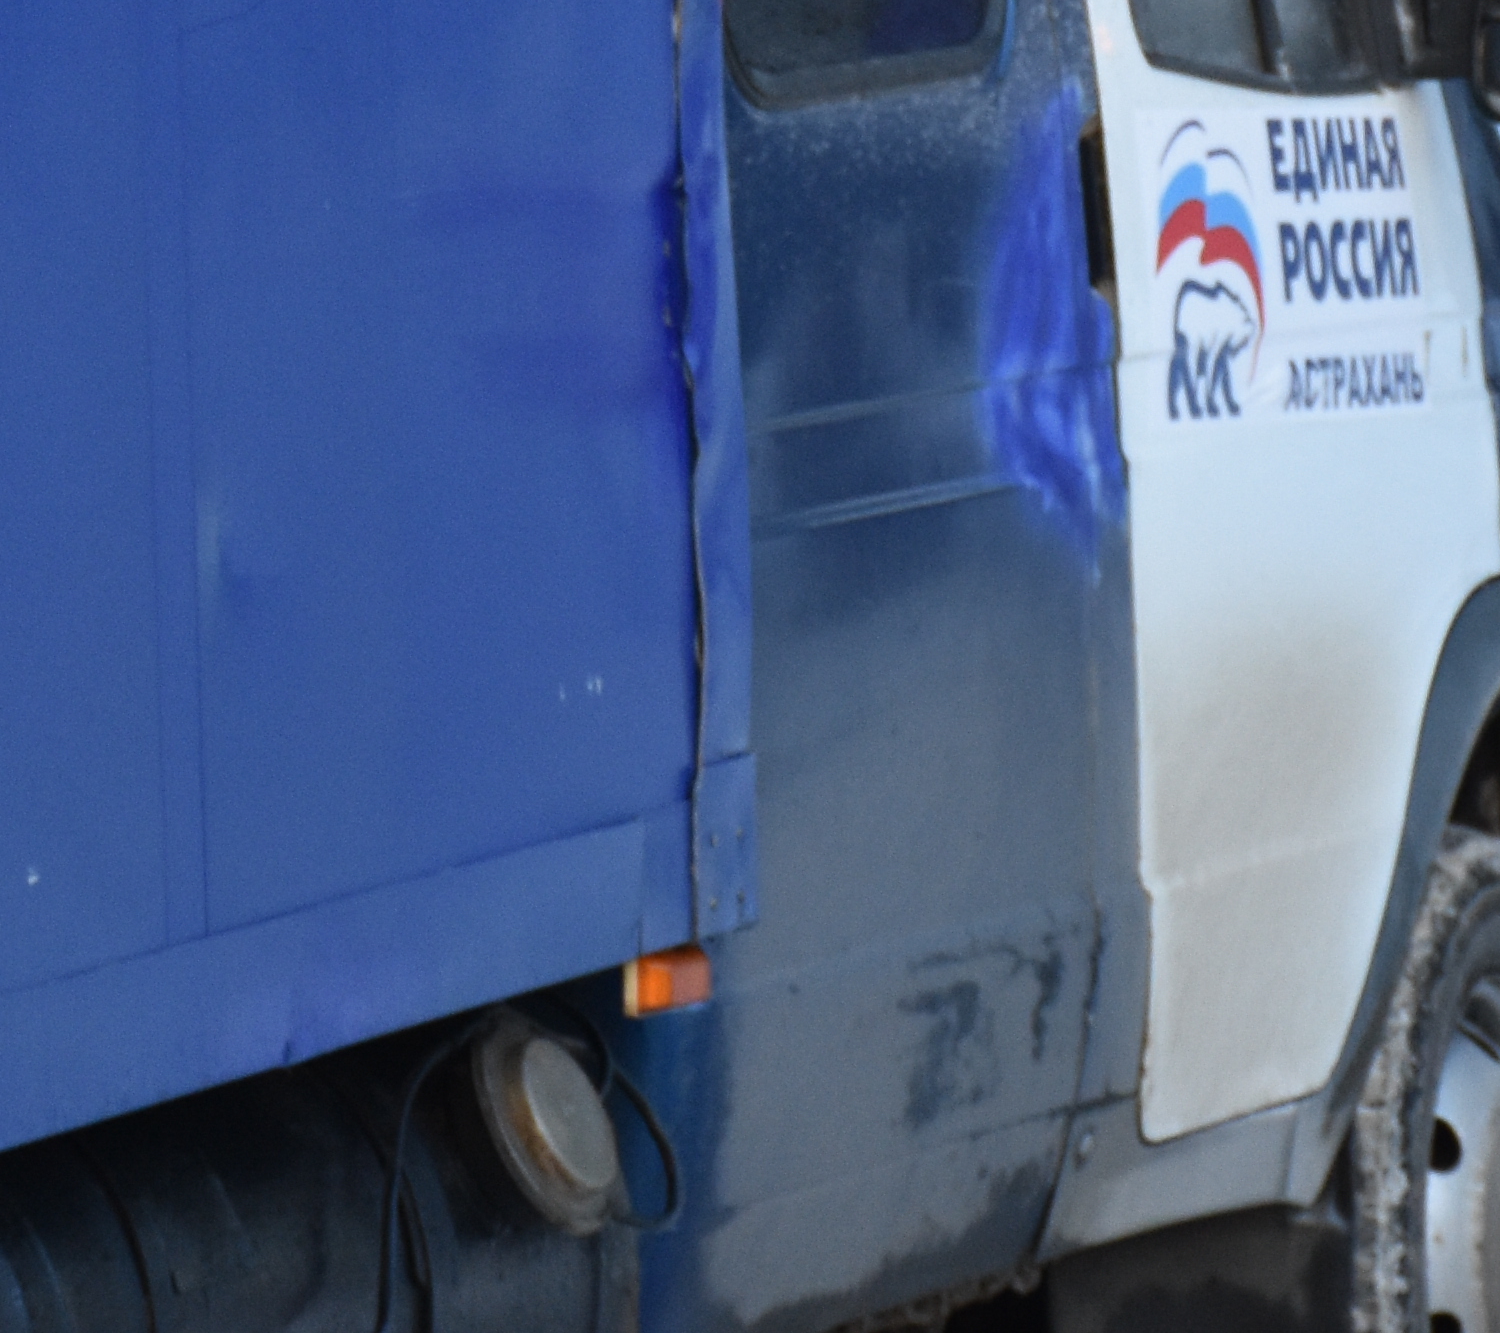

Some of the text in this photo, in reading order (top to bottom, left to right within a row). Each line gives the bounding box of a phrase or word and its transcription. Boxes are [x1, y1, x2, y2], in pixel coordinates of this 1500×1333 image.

[1266, 117, 1405, 202] ЕДИНАЯ
[1279, 219, 1419, 302] РОССИЯ
[1285, 352, 1424, 412] АСТРАХАНЬ
